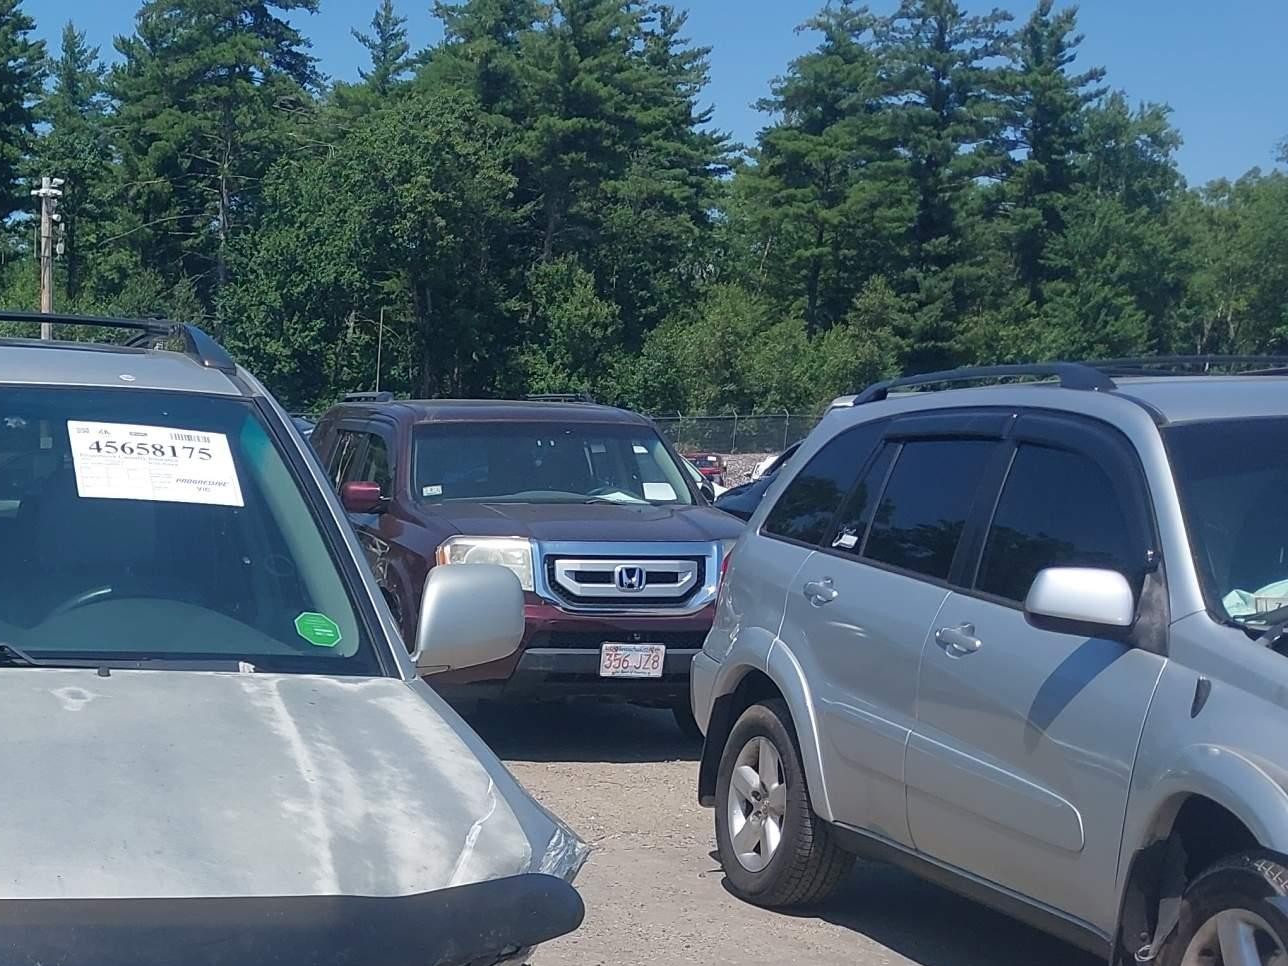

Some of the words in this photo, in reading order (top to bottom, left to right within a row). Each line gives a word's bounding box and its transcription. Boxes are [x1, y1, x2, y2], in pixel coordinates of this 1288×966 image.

[89, 441, 212, 461] 45658175
[604, 652, 630, 670] 356
[633, 652, 660, 670] JZ8
